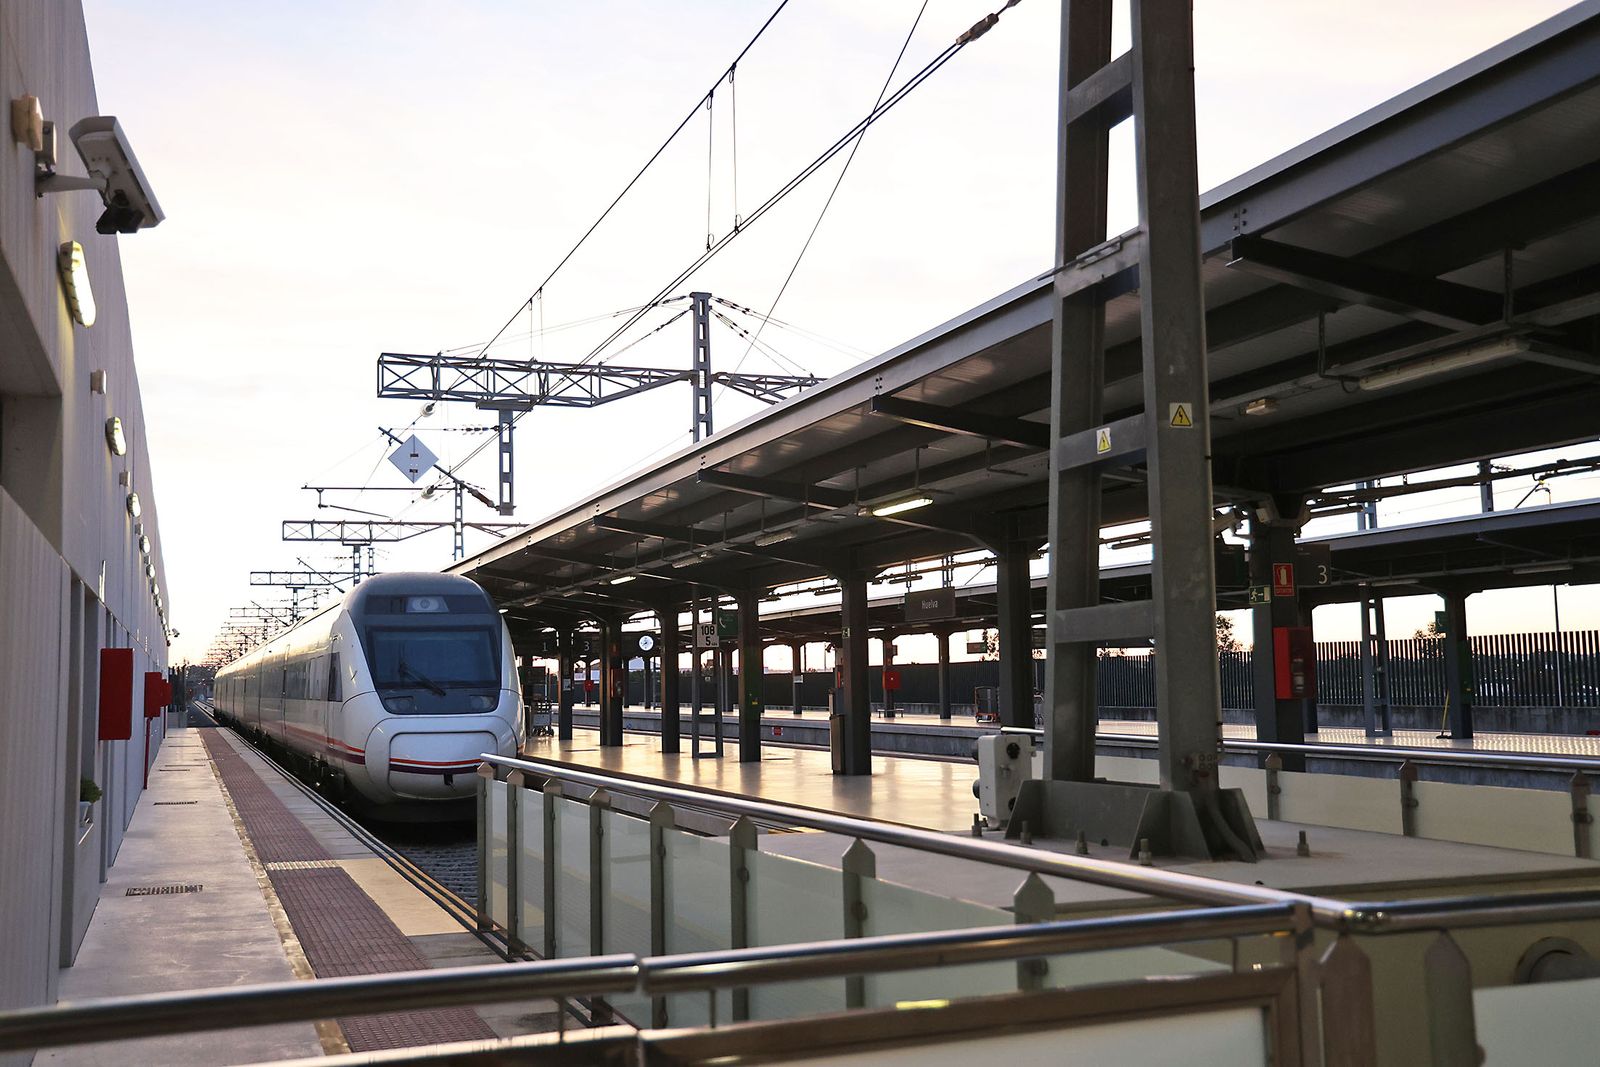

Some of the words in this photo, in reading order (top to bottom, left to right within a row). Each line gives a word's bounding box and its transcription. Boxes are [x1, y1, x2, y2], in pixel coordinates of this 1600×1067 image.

[1318, 564, 1328, 585] 3
[701, 625, 715, 636] 108
[705, 636, 711, 646] 5
